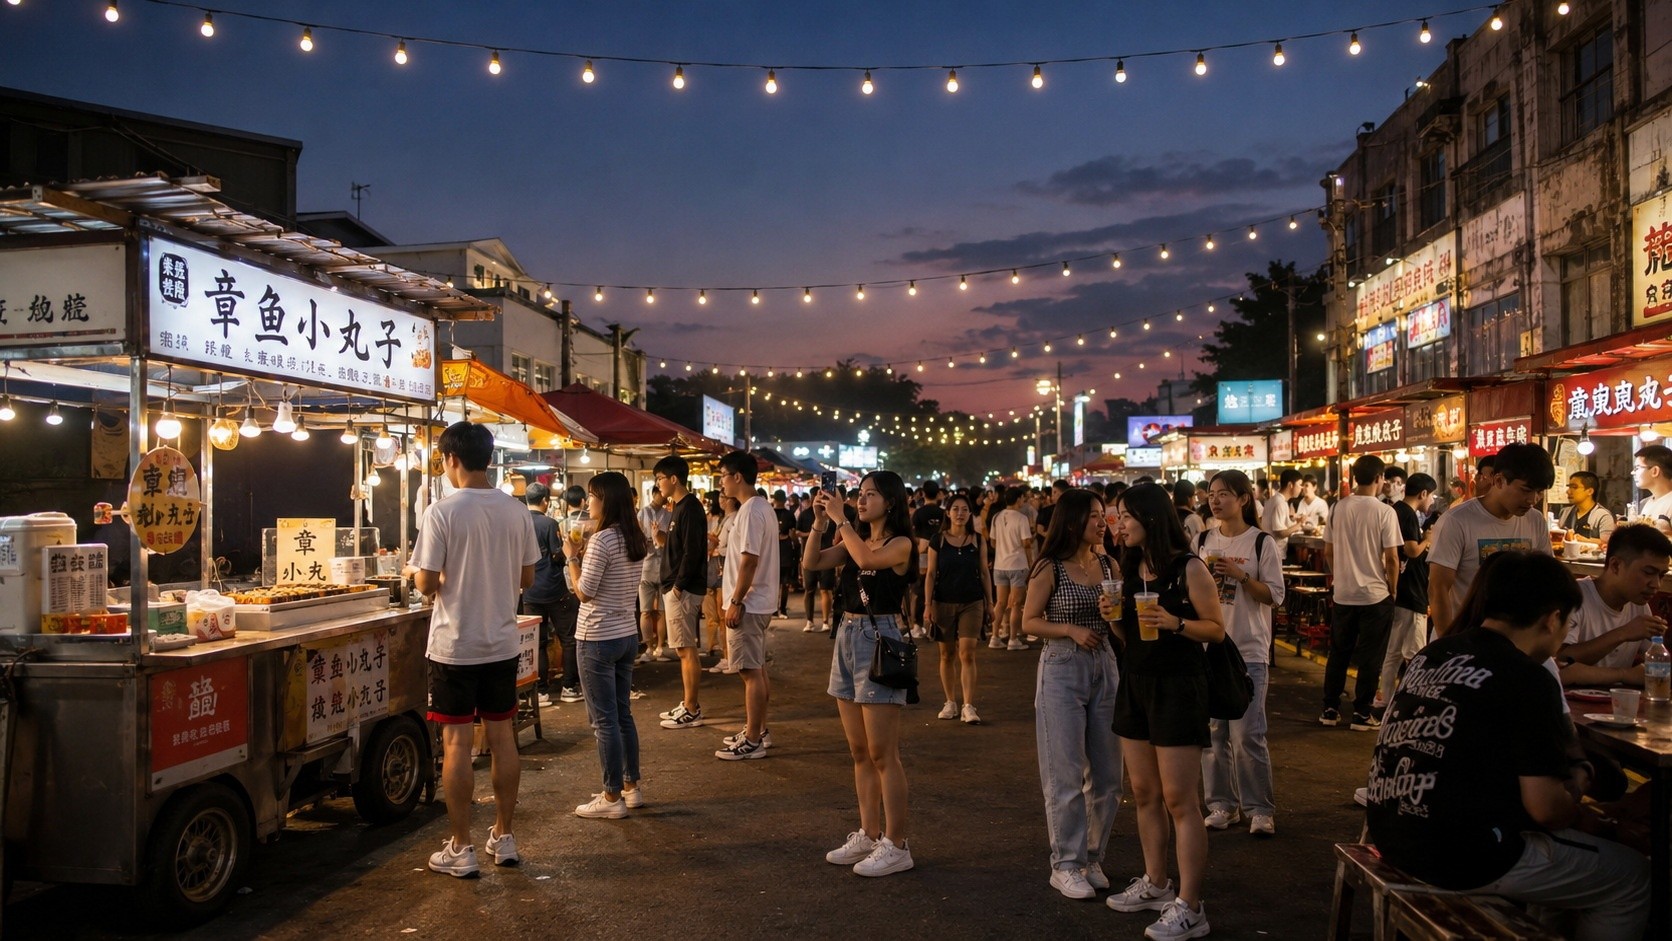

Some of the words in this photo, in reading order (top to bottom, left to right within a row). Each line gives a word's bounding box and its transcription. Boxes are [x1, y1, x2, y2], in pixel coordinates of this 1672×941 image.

[204, 268, 402, 369] 章鱼小丸子
[293, 529, 317, 556] 章
